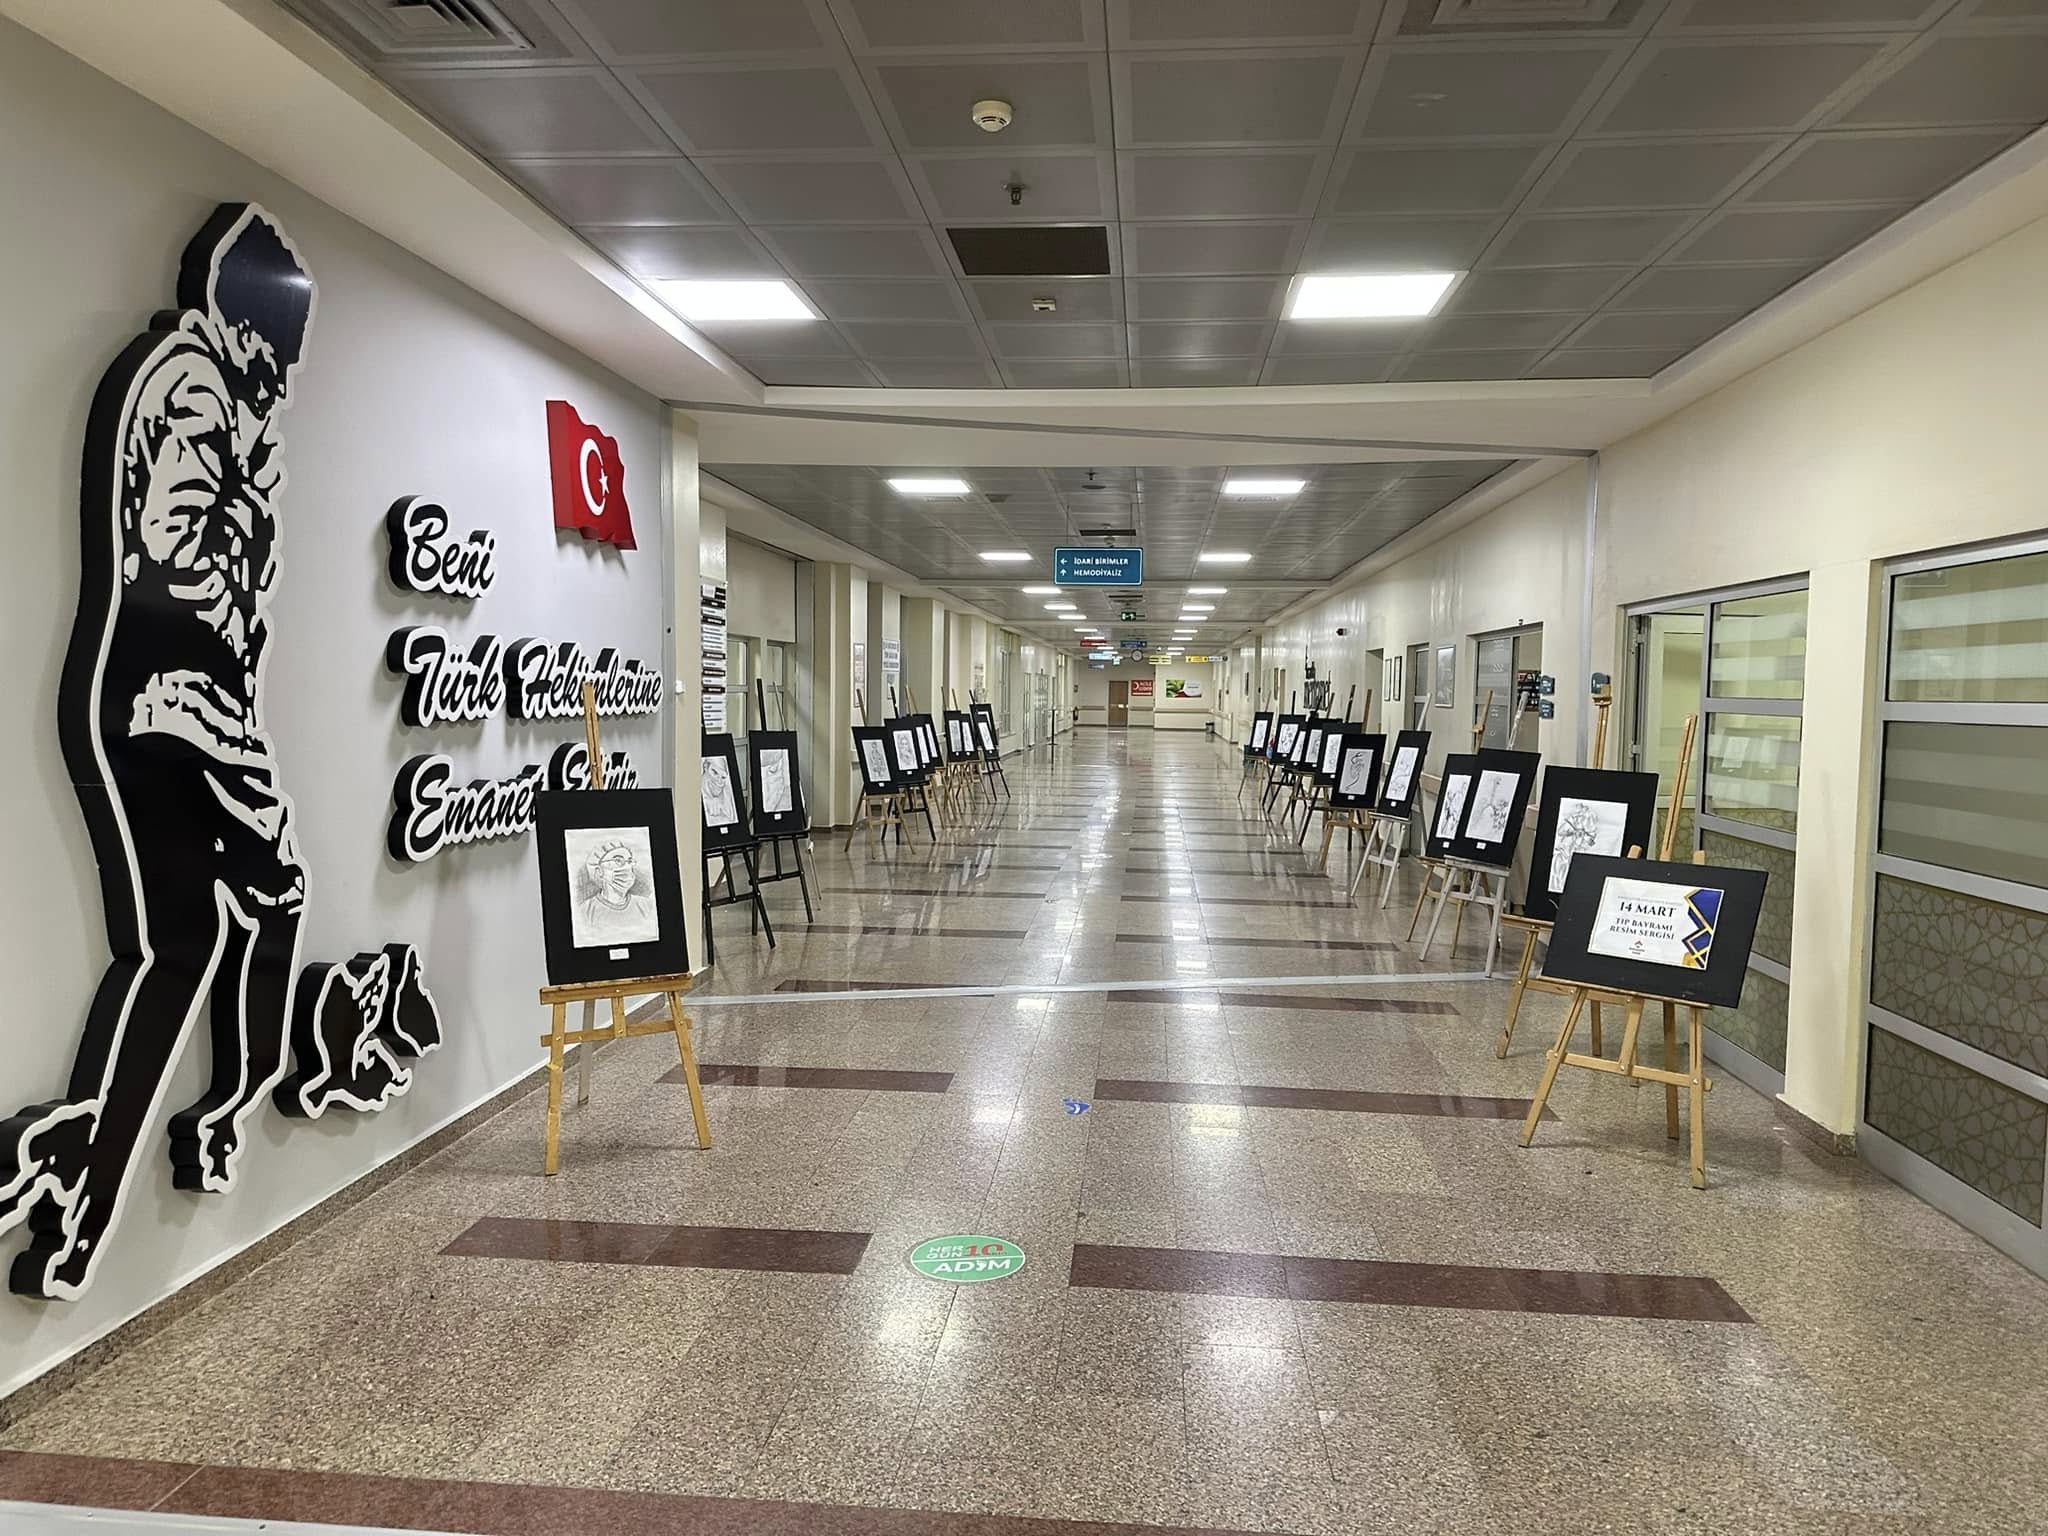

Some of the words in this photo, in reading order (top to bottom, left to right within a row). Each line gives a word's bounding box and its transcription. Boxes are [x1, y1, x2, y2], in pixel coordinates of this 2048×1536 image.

[407, 502, 496, 592] Beni
[1073, 556, 1094, 565] İDARİ
[1095, 556, 1129, 565] BİRİMLER
[1073, 568, 1122, 577] HEMODİYALİZ
[407, 632, 502, 721] Türk
[1620, 902, 1632, 912] 14
[1635, 904, 1677, 918] MART
[1631, 919, 1673, 932] BAYRAMI
